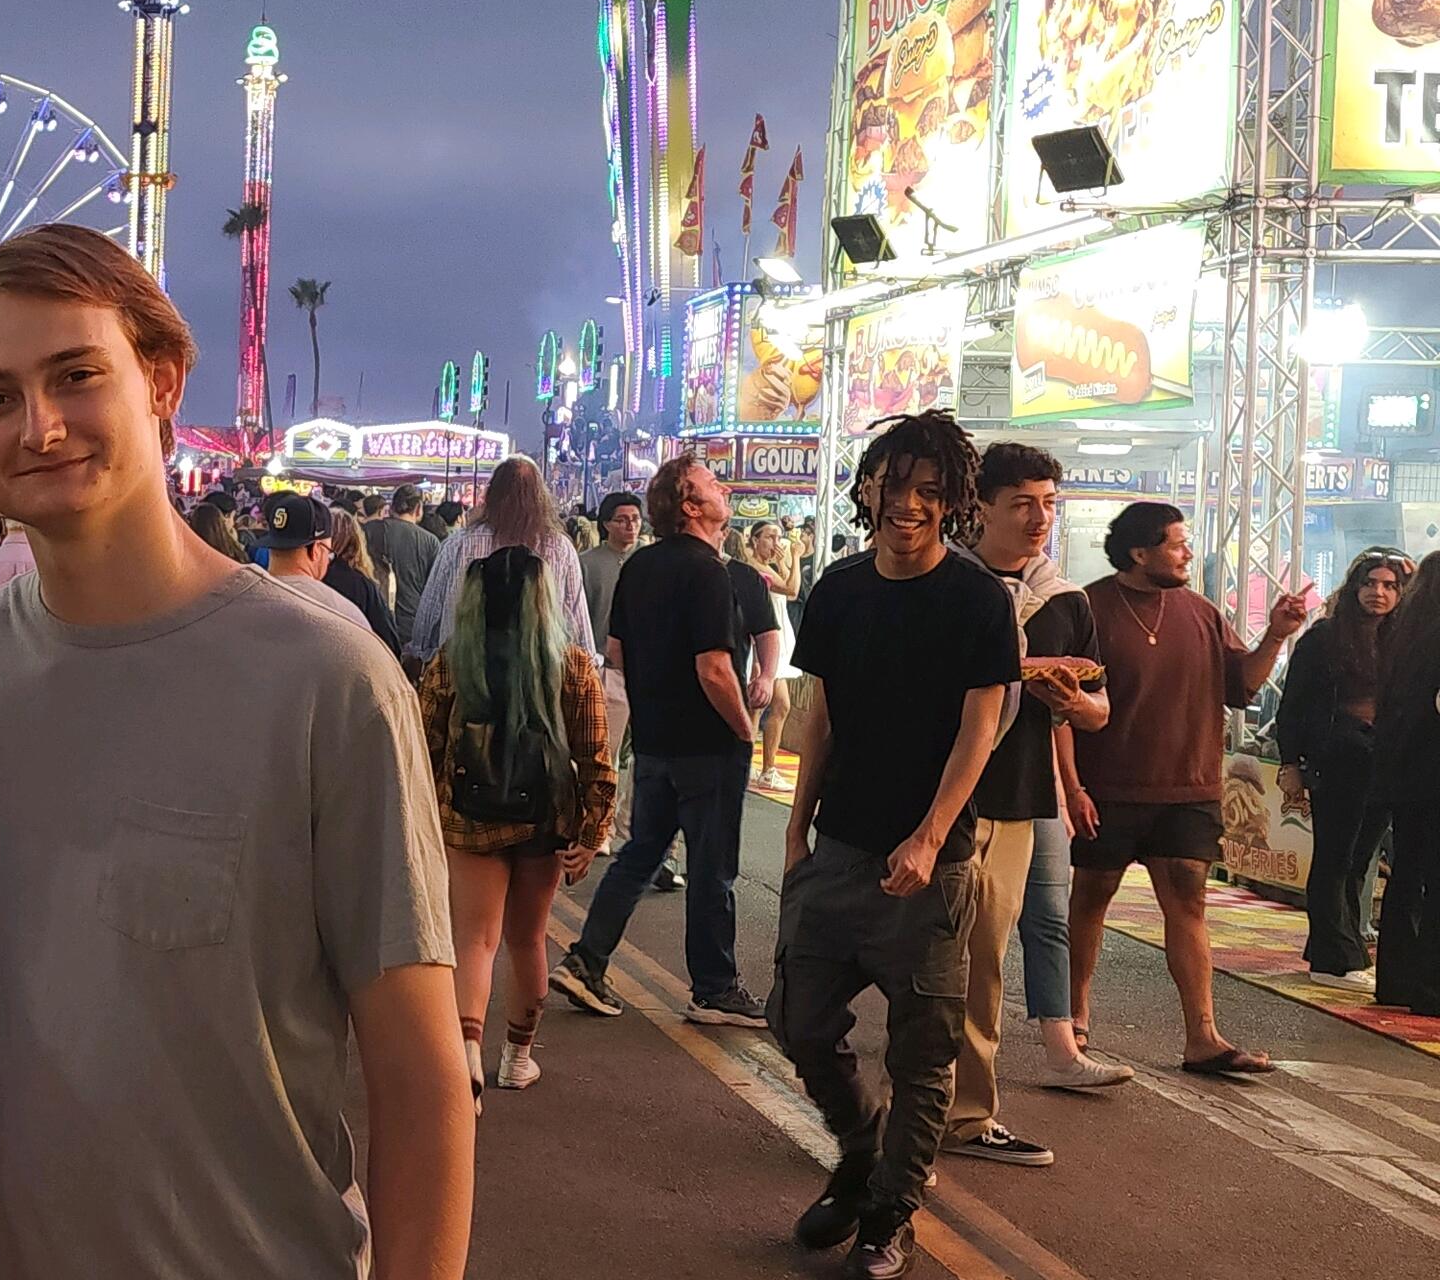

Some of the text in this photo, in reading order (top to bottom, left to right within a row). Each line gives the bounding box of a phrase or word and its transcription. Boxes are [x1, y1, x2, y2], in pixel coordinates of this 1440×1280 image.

[367, 432, 422, 456] WATER
[423, 431, 462, 458] GUN
[753, 447, 847, 475] GOURMT
[1250, 847, 1300, 881] FRIES
